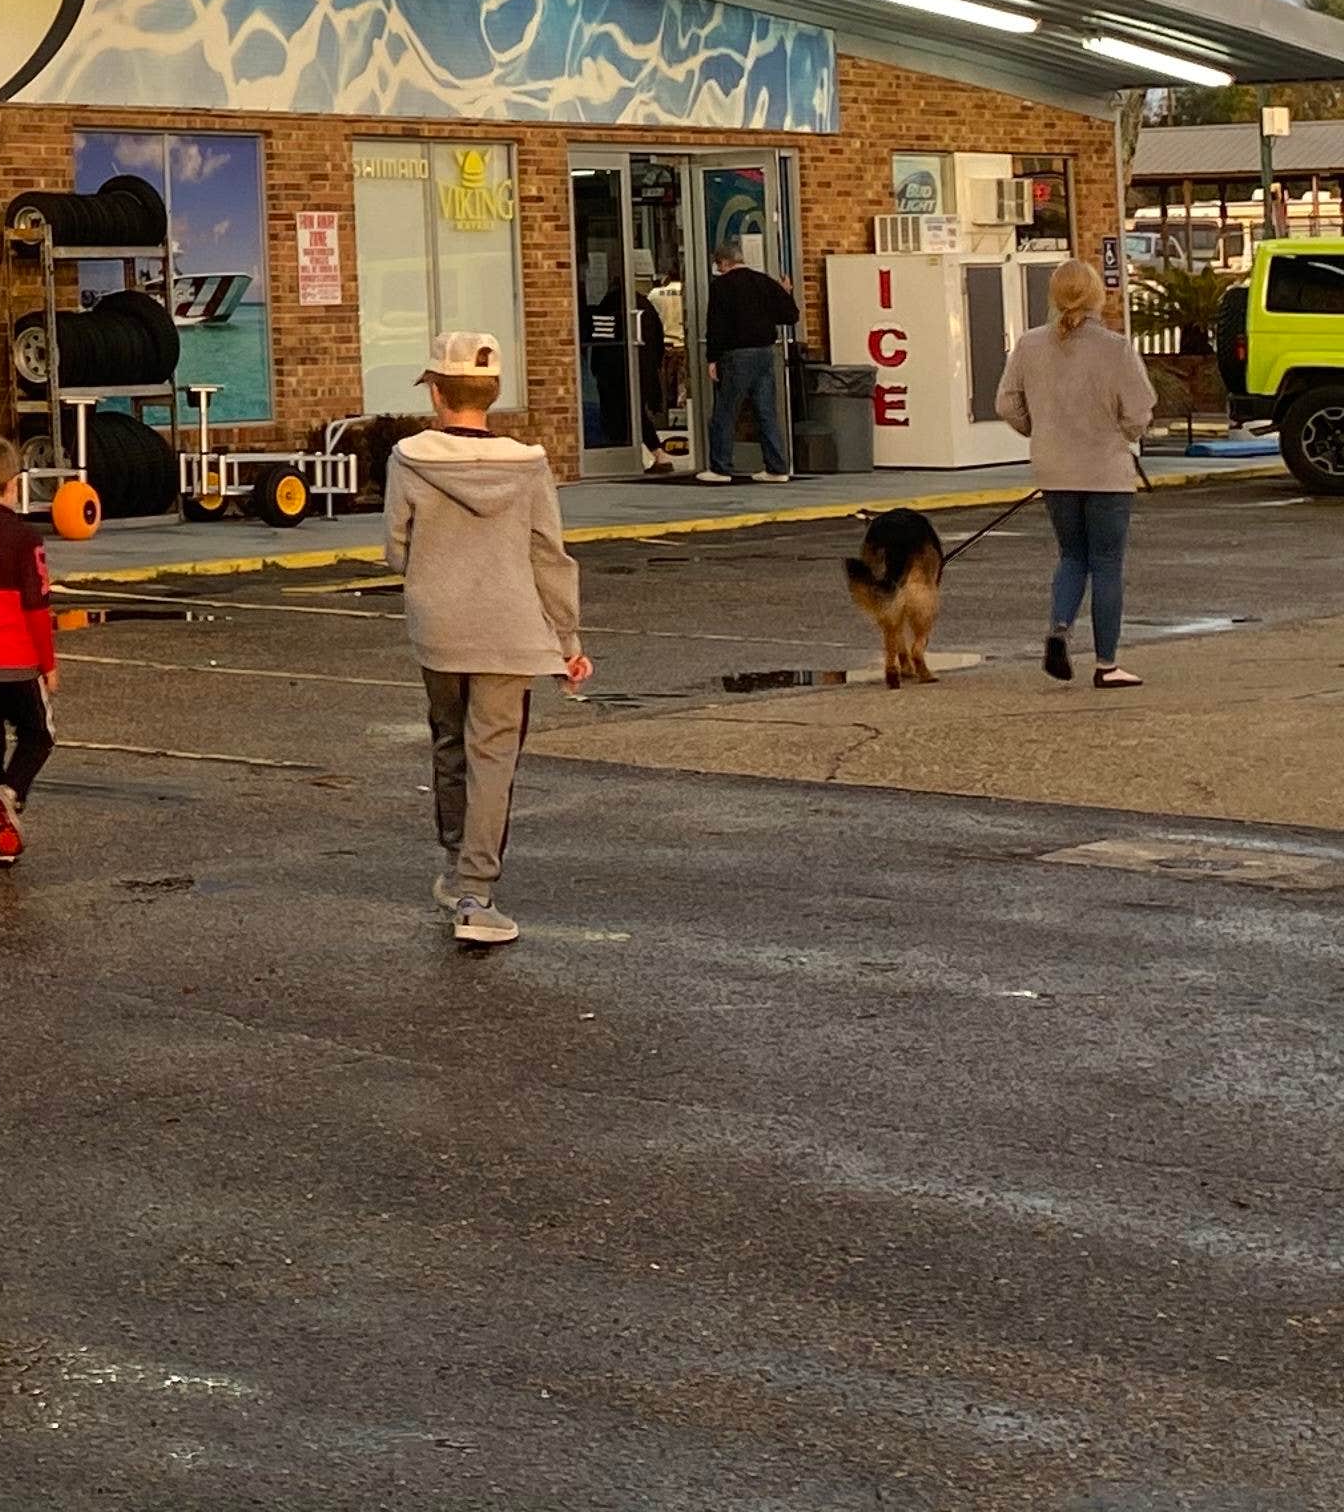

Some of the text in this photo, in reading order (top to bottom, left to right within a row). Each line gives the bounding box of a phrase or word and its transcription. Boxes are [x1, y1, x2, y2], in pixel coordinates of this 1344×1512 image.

[353, 158, 429, 179] SHIMANO
[437, 179, 514, 221] VIKING
[868, 269, 909, 426] ICE
